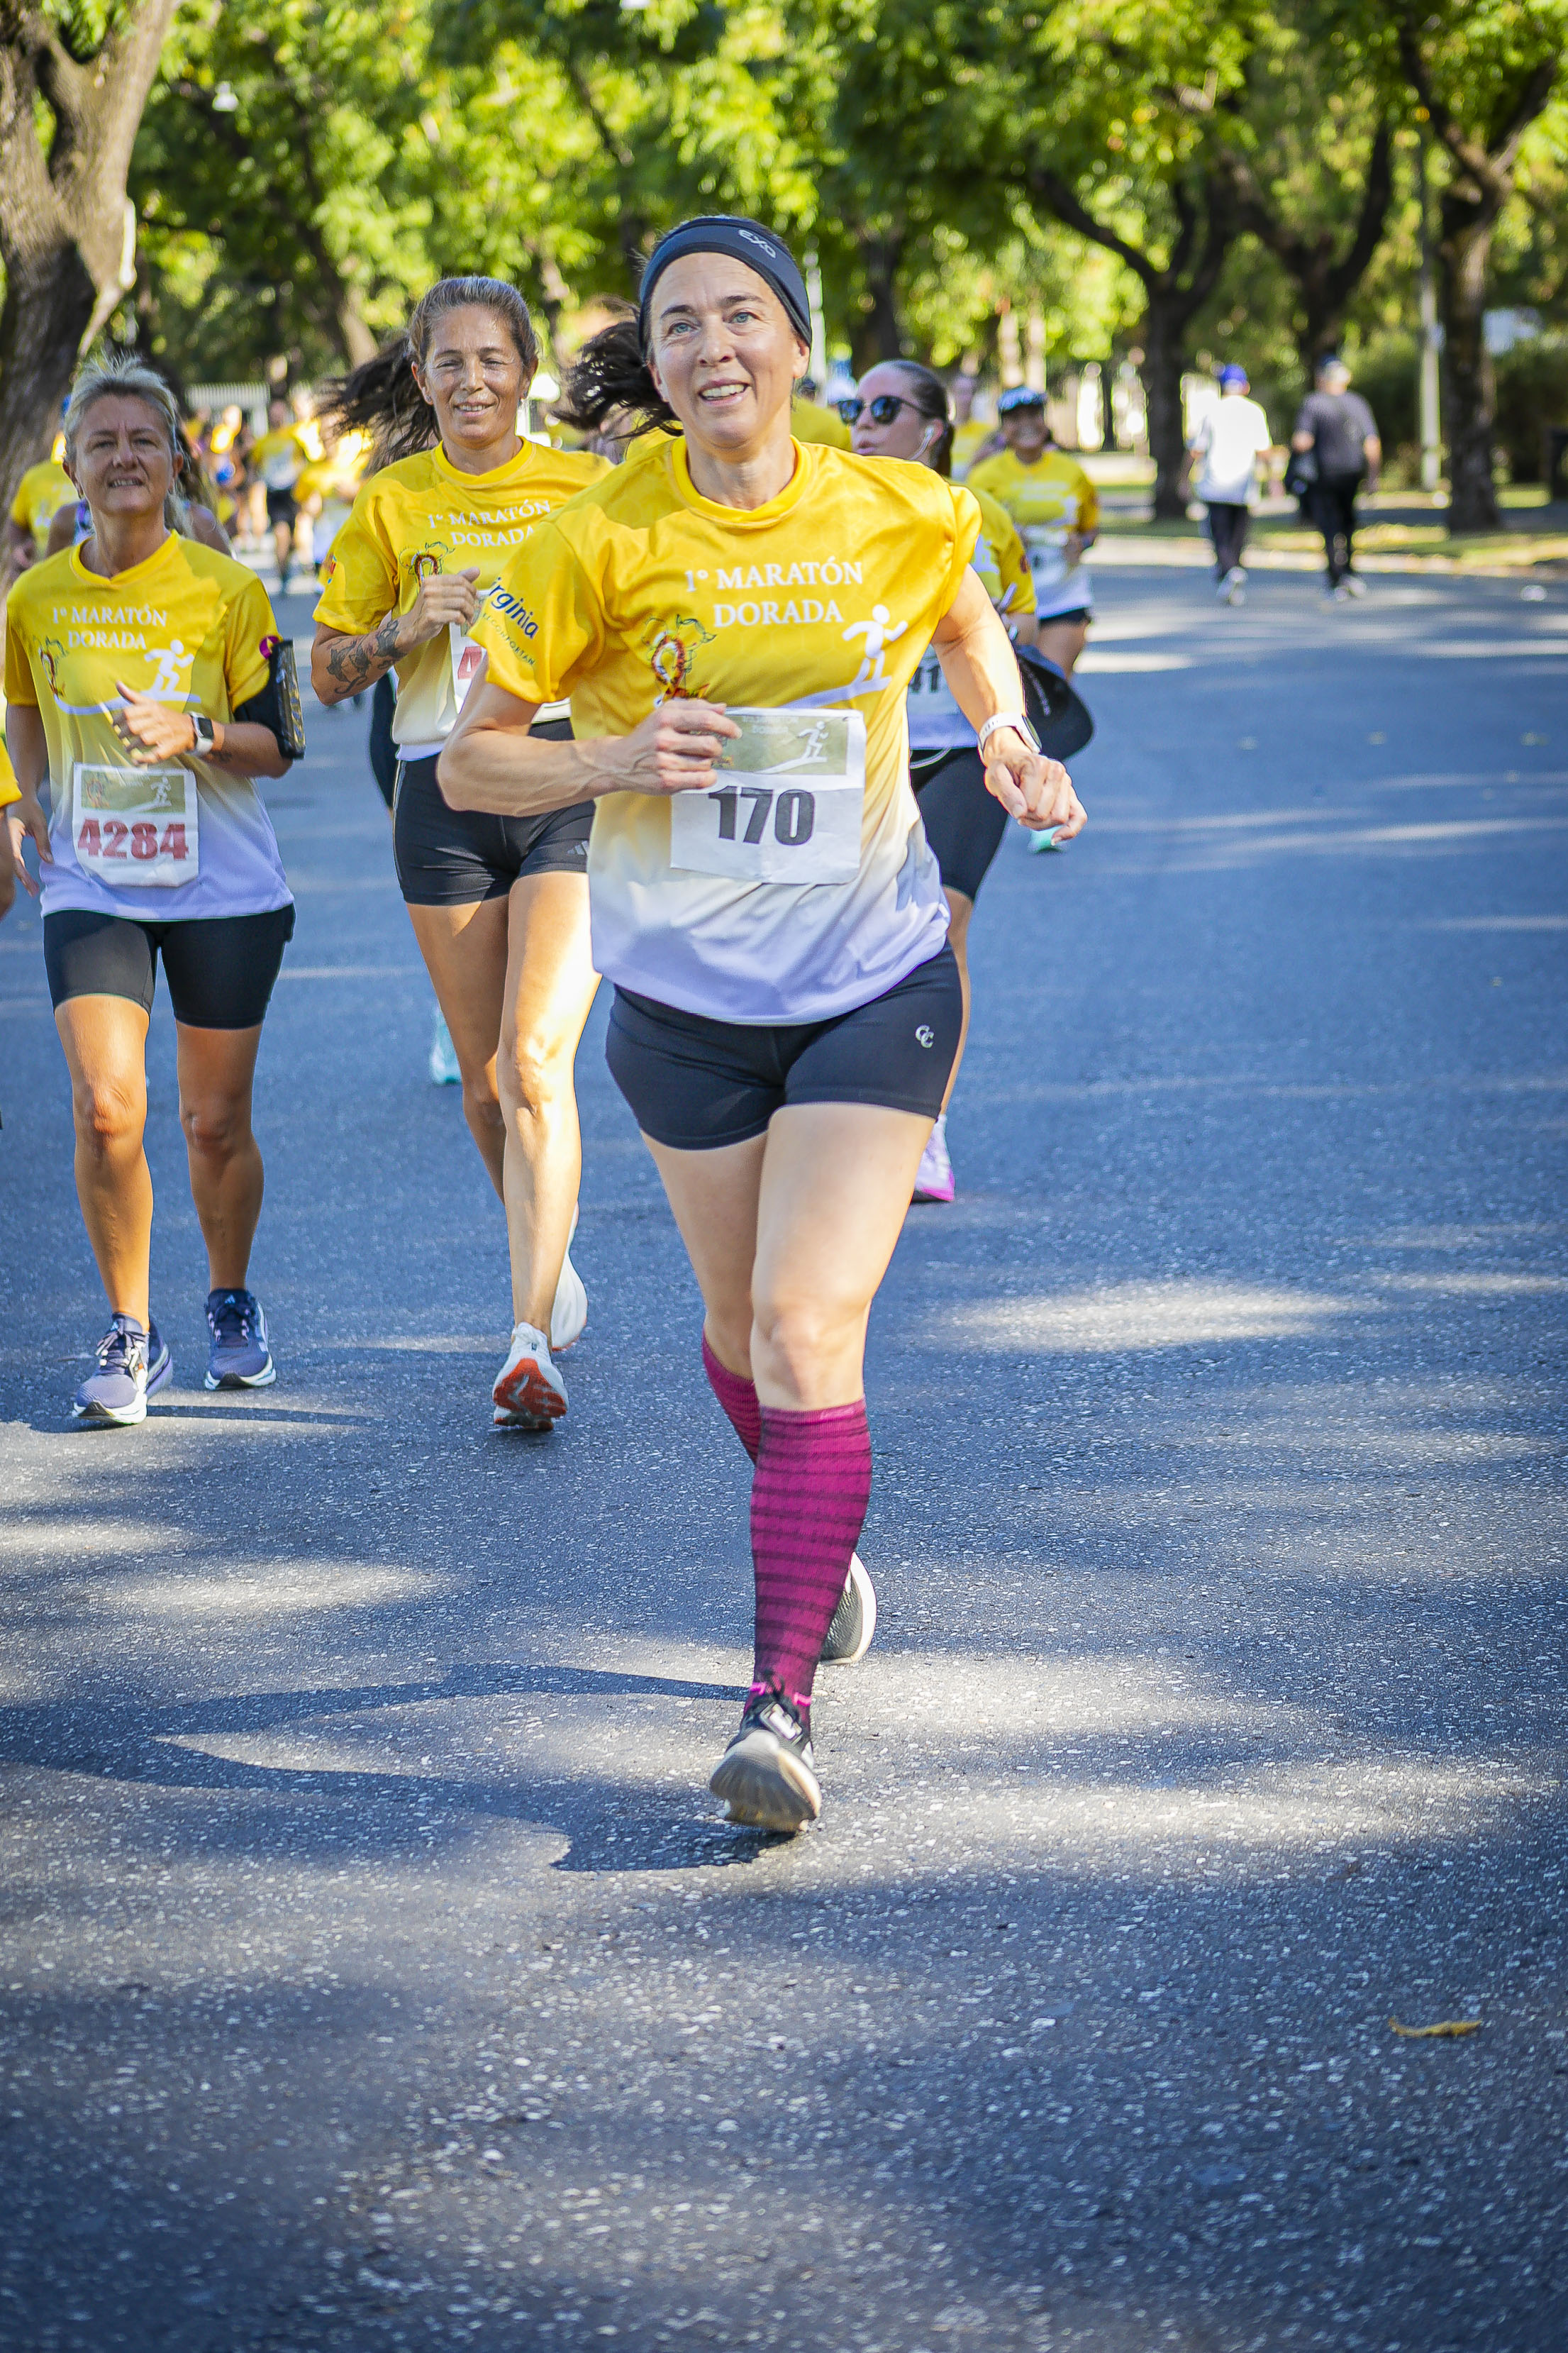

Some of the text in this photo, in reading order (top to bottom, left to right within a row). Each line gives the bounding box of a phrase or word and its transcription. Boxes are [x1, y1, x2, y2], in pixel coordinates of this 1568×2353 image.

[448, 499, 551, 526] MARATÓN
[715, 555, 863, 589] MARATÓN
[71, 604, 167, 627] MARATÓN
[713, 599, 843, 628] DORADA
[68, 630, 147, 650] DORADA
[708, 785, 815, 846] 170
[77, 818, 190, 860] 4284
